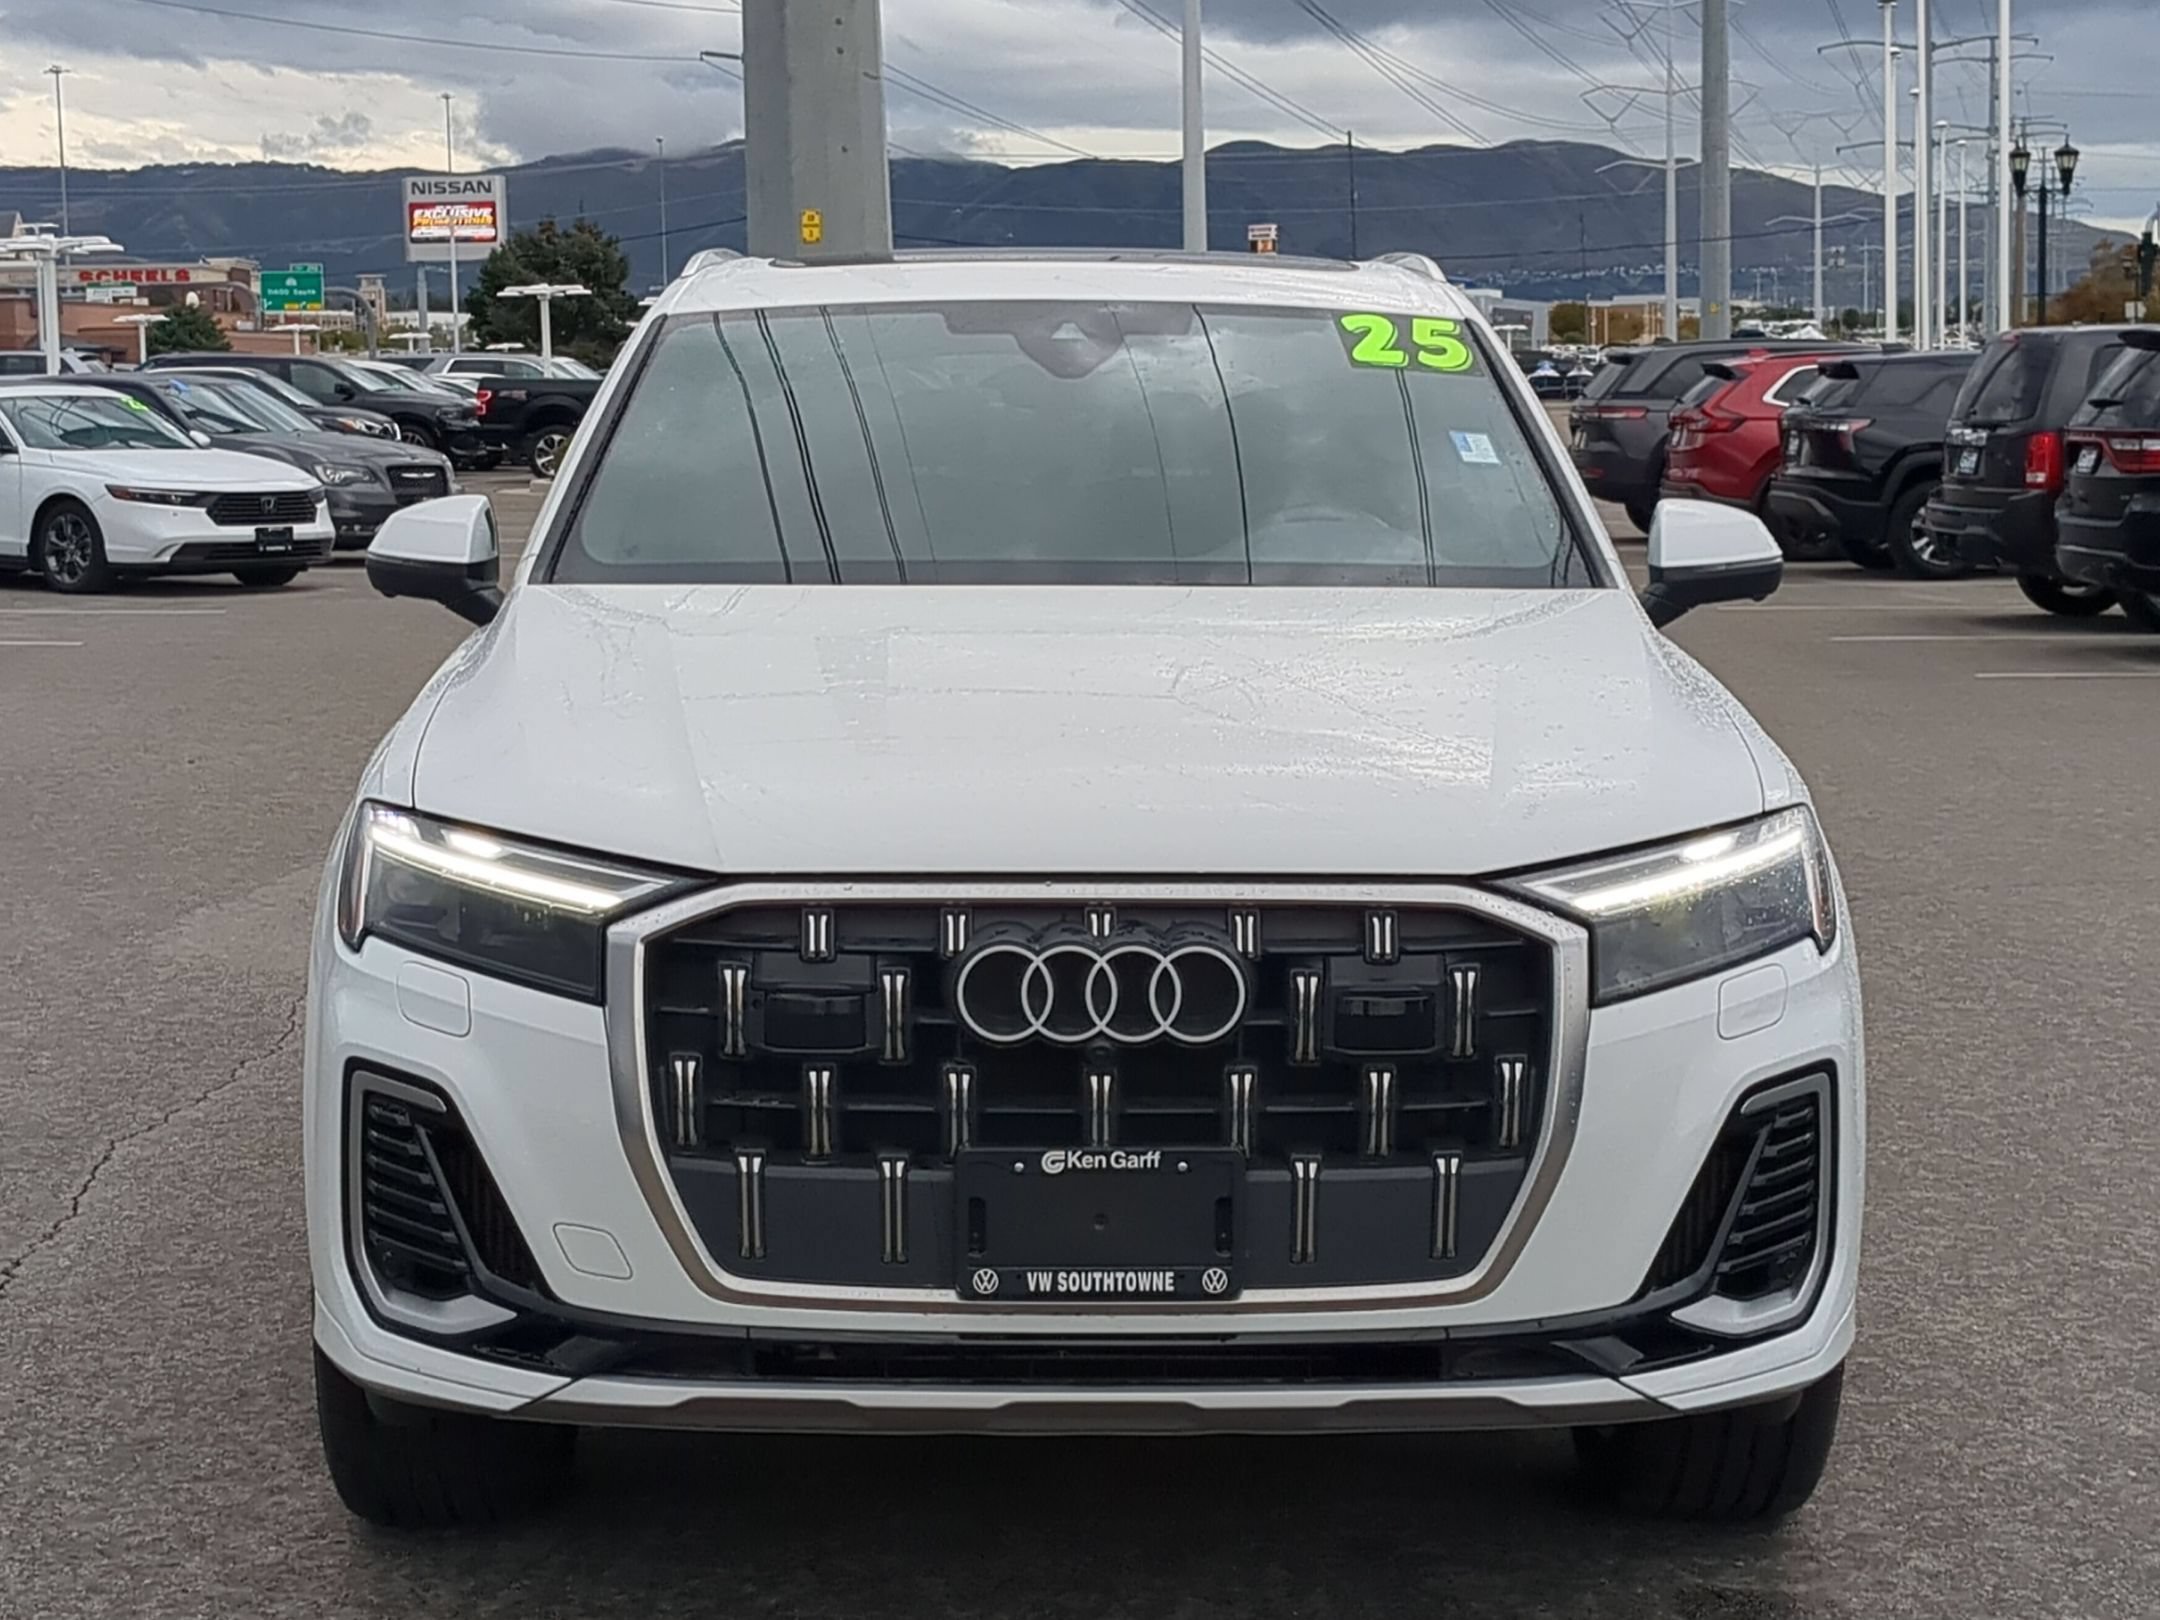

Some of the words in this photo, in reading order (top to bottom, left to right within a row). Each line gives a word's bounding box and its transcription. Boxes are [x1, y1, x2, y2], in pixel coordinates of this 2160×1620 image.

[411, 181, 492, 195] NISSAN
[413, 206, 493, 218] EXCLUSIVE
[78, 268, 191, 283] SCHEELS
[1340, 313, 1474, 372] 25
[1066, 1150, 1107, 1169] Ken
[1110, 1150, 1161, 1169] Garff
[1026, 1271, 1052, 1292] VW
[1057, 1271, 1175, 1292] SOUTHTOWNE
